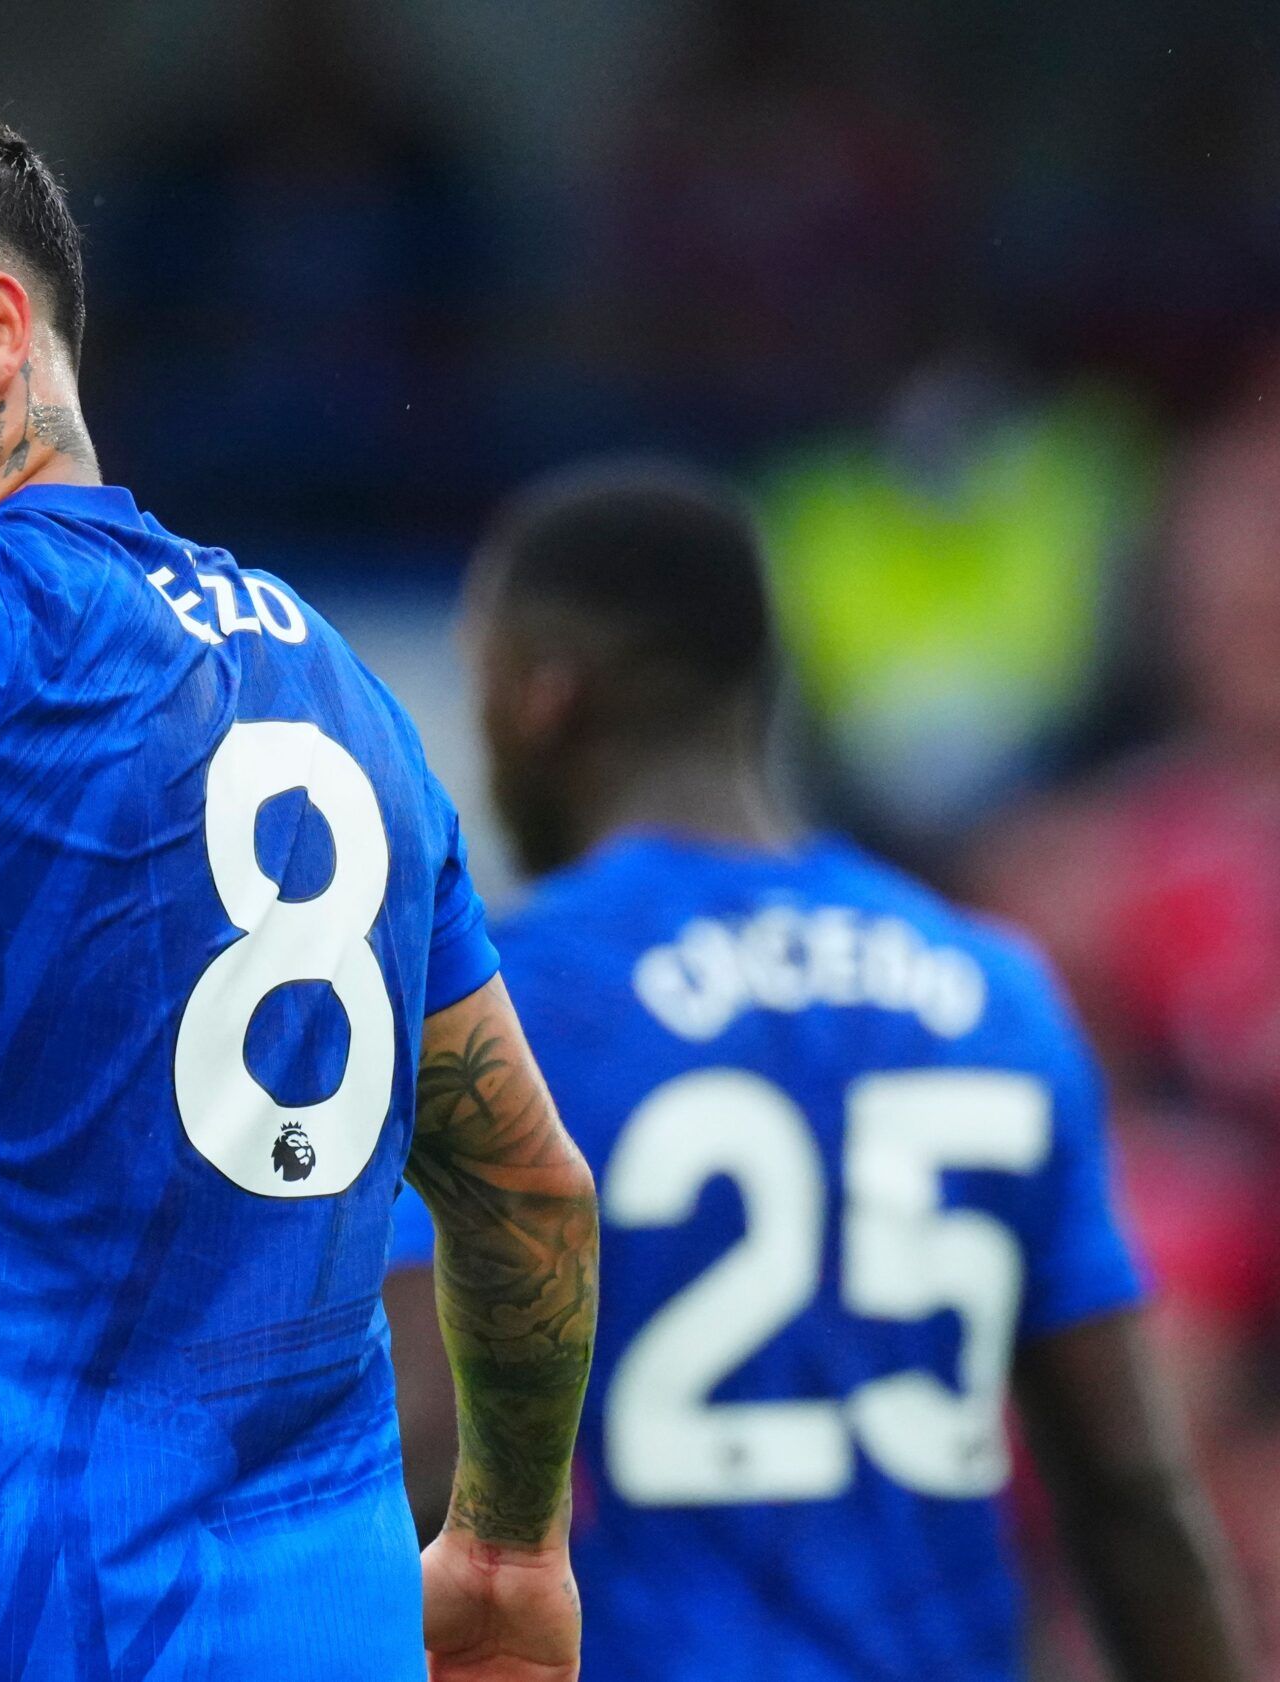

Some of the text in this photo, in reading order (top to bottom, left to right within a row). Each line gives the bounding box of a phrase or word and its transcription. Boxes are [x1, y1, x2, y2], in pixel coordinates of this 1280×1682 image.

[146, 549, 307, 644] EZO
[174, 721, 395, 1198] 8
[602, 1065, 1053, 1506] 25
